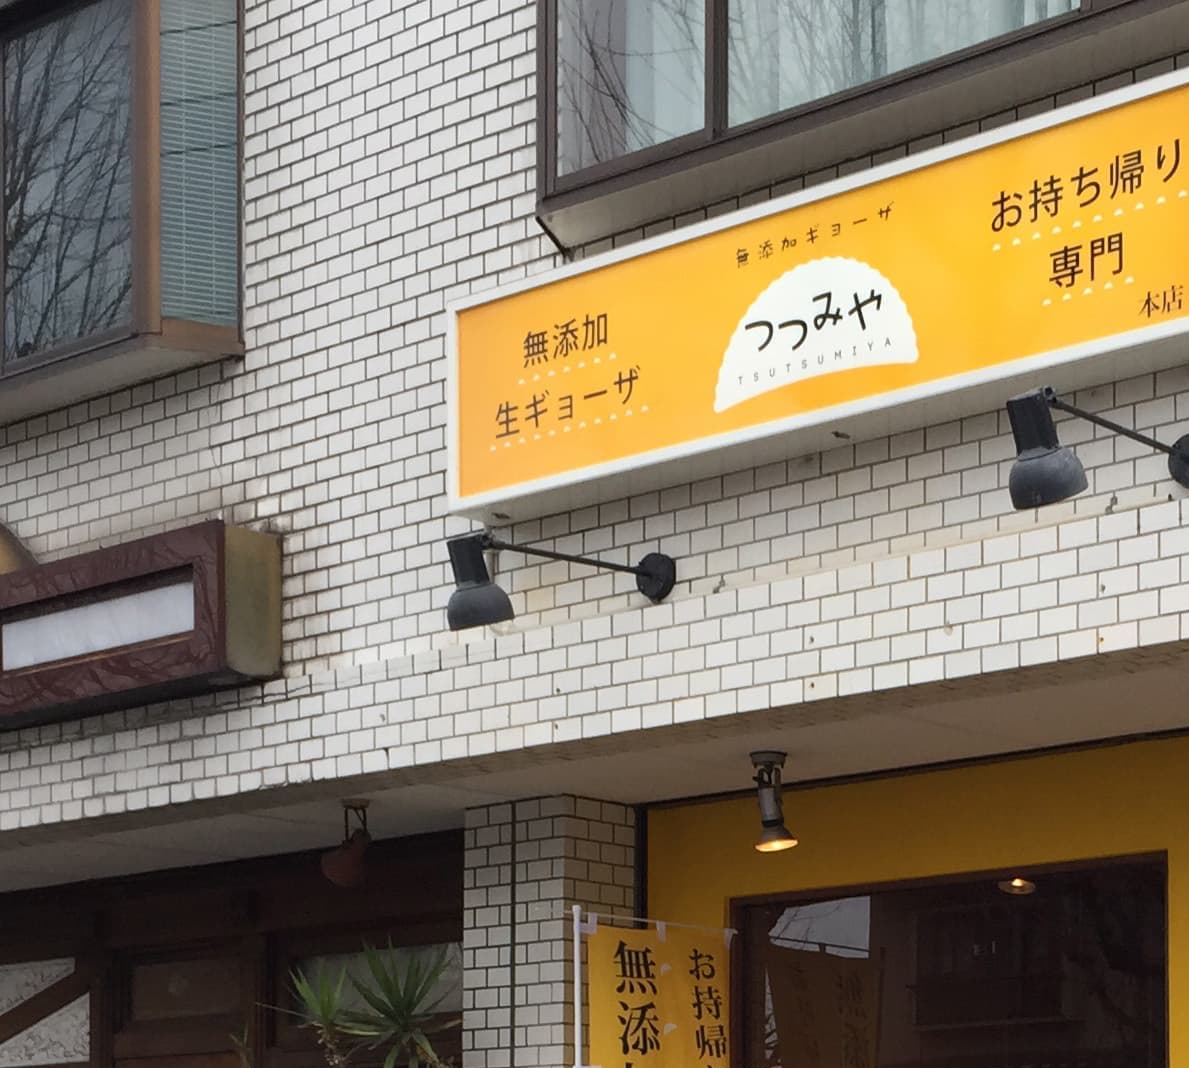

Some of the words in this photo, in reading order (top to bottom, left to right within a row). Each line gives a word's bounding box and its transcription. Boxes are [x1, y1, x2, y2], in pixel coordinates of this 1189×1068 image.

[990, 138, 1181, 232] お持ち帰り
[736, 201, 895, 268] 無添加ギョーザ
[1049, 232, 1124, 289] 専門
[523, 313, 608, 368] 無添加
[744, 289, 882, 352] つつみや
[737, 337, 892, 385] TSUTSUMIYA
[495, 365, 641, 439] 生ギョーザ
